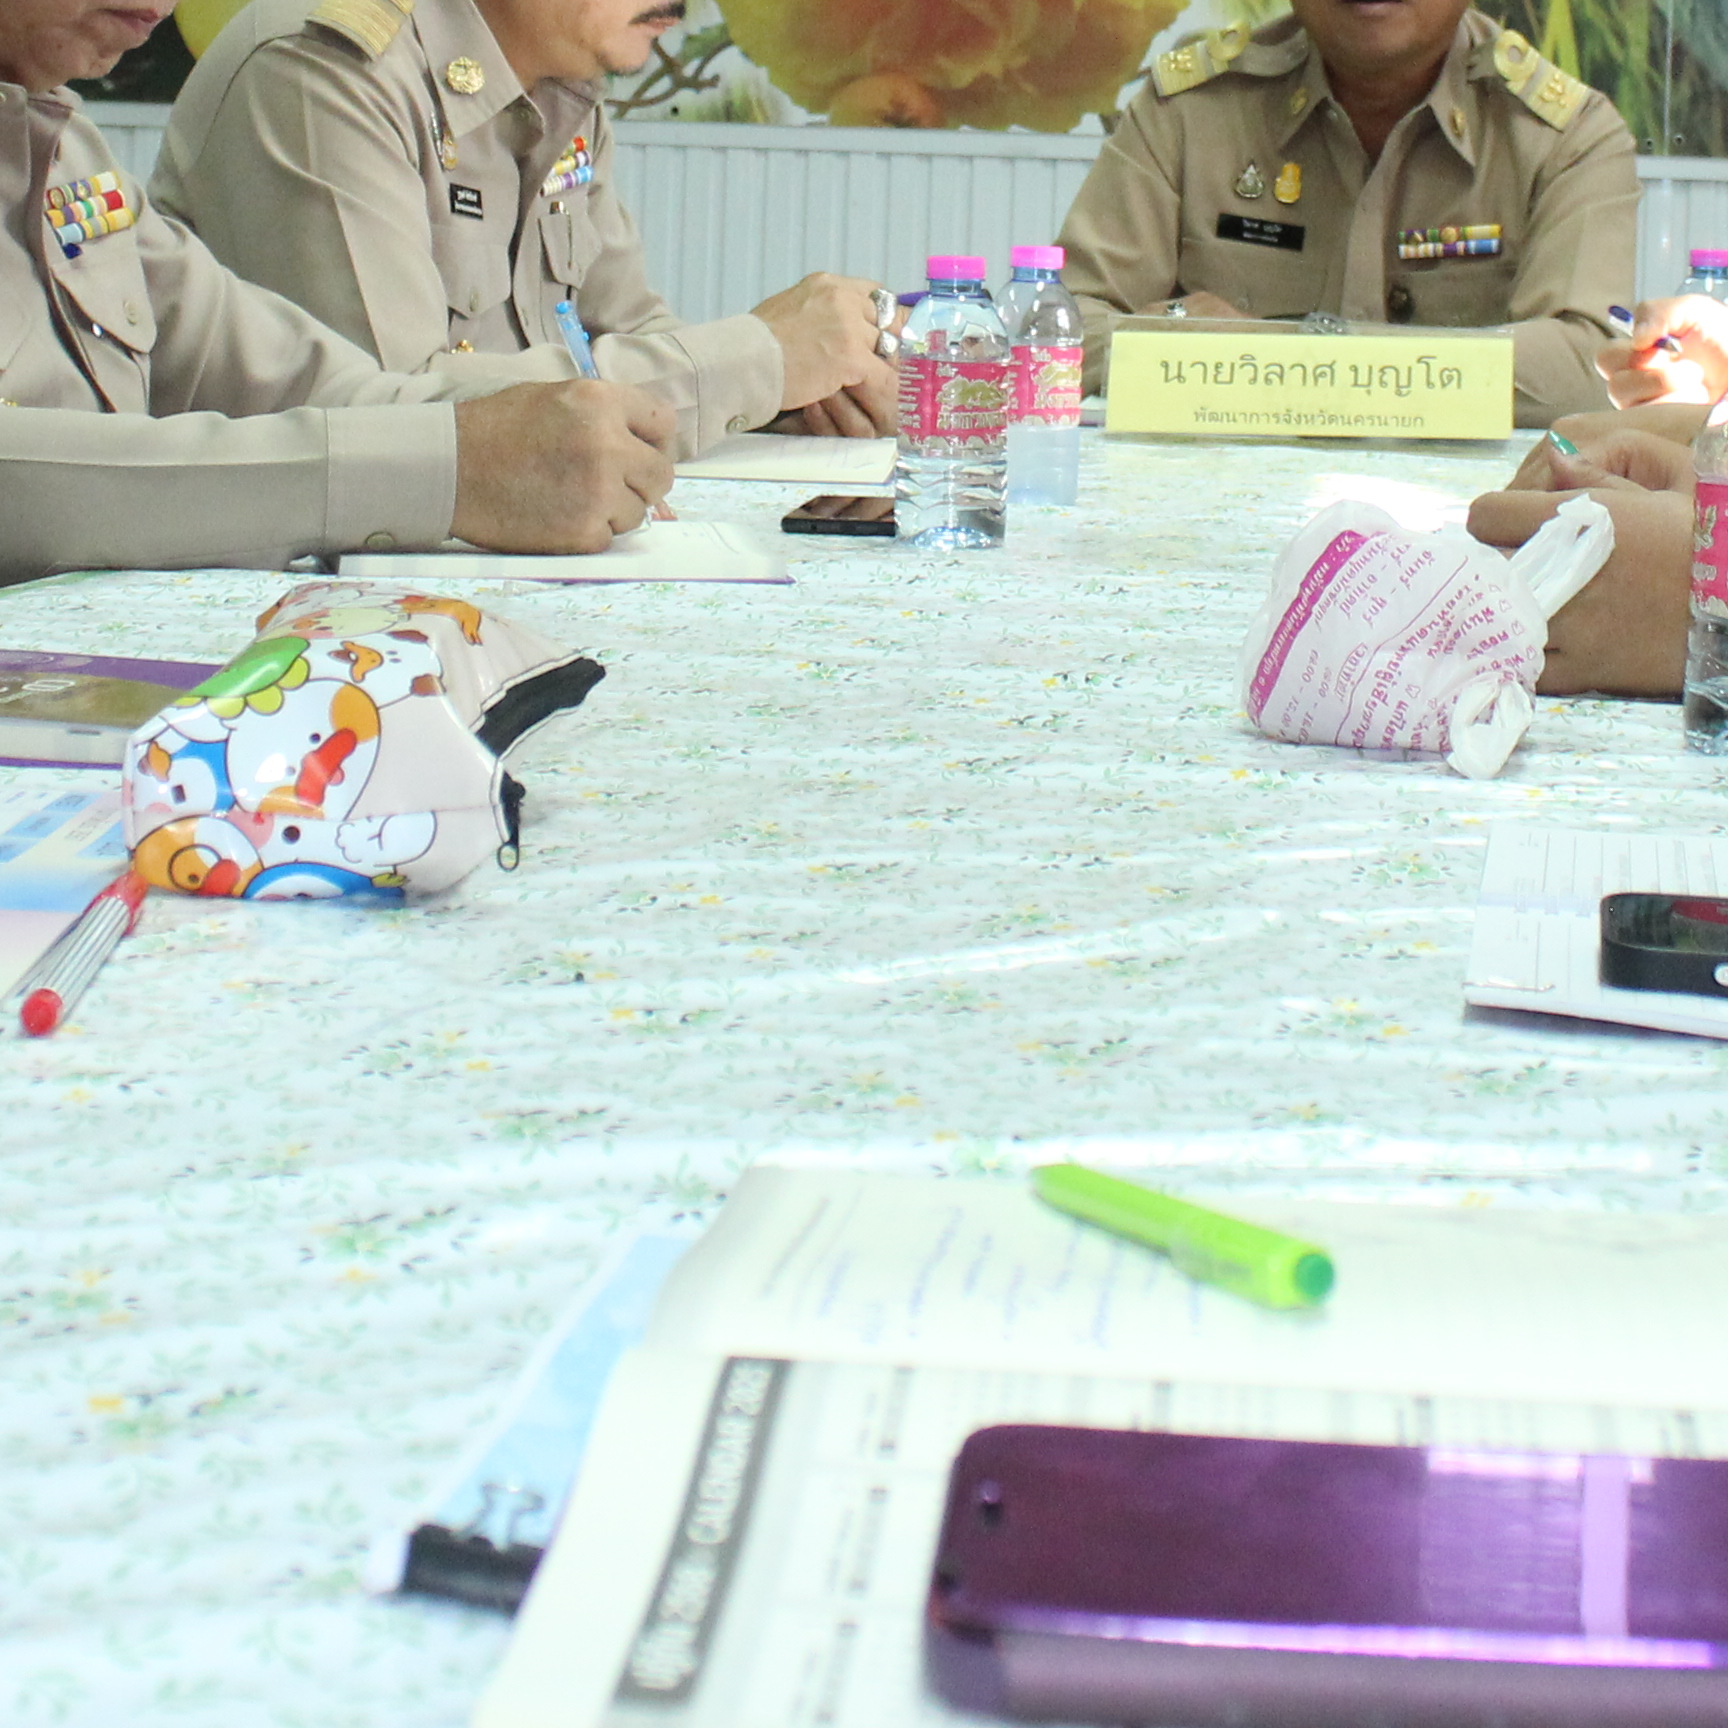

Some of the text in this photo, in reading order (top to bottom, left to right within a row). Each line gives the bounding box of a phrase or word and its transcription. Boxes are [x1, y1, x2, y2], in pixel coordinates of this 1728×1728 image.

[1159, 353, 1463, 397] นายวิลาศ บุญโต
[1192, 406, 1425, 428] พัฒนาการจังหวัดนครนายก
[685, 1414, 758, 1546] CALENDAR
